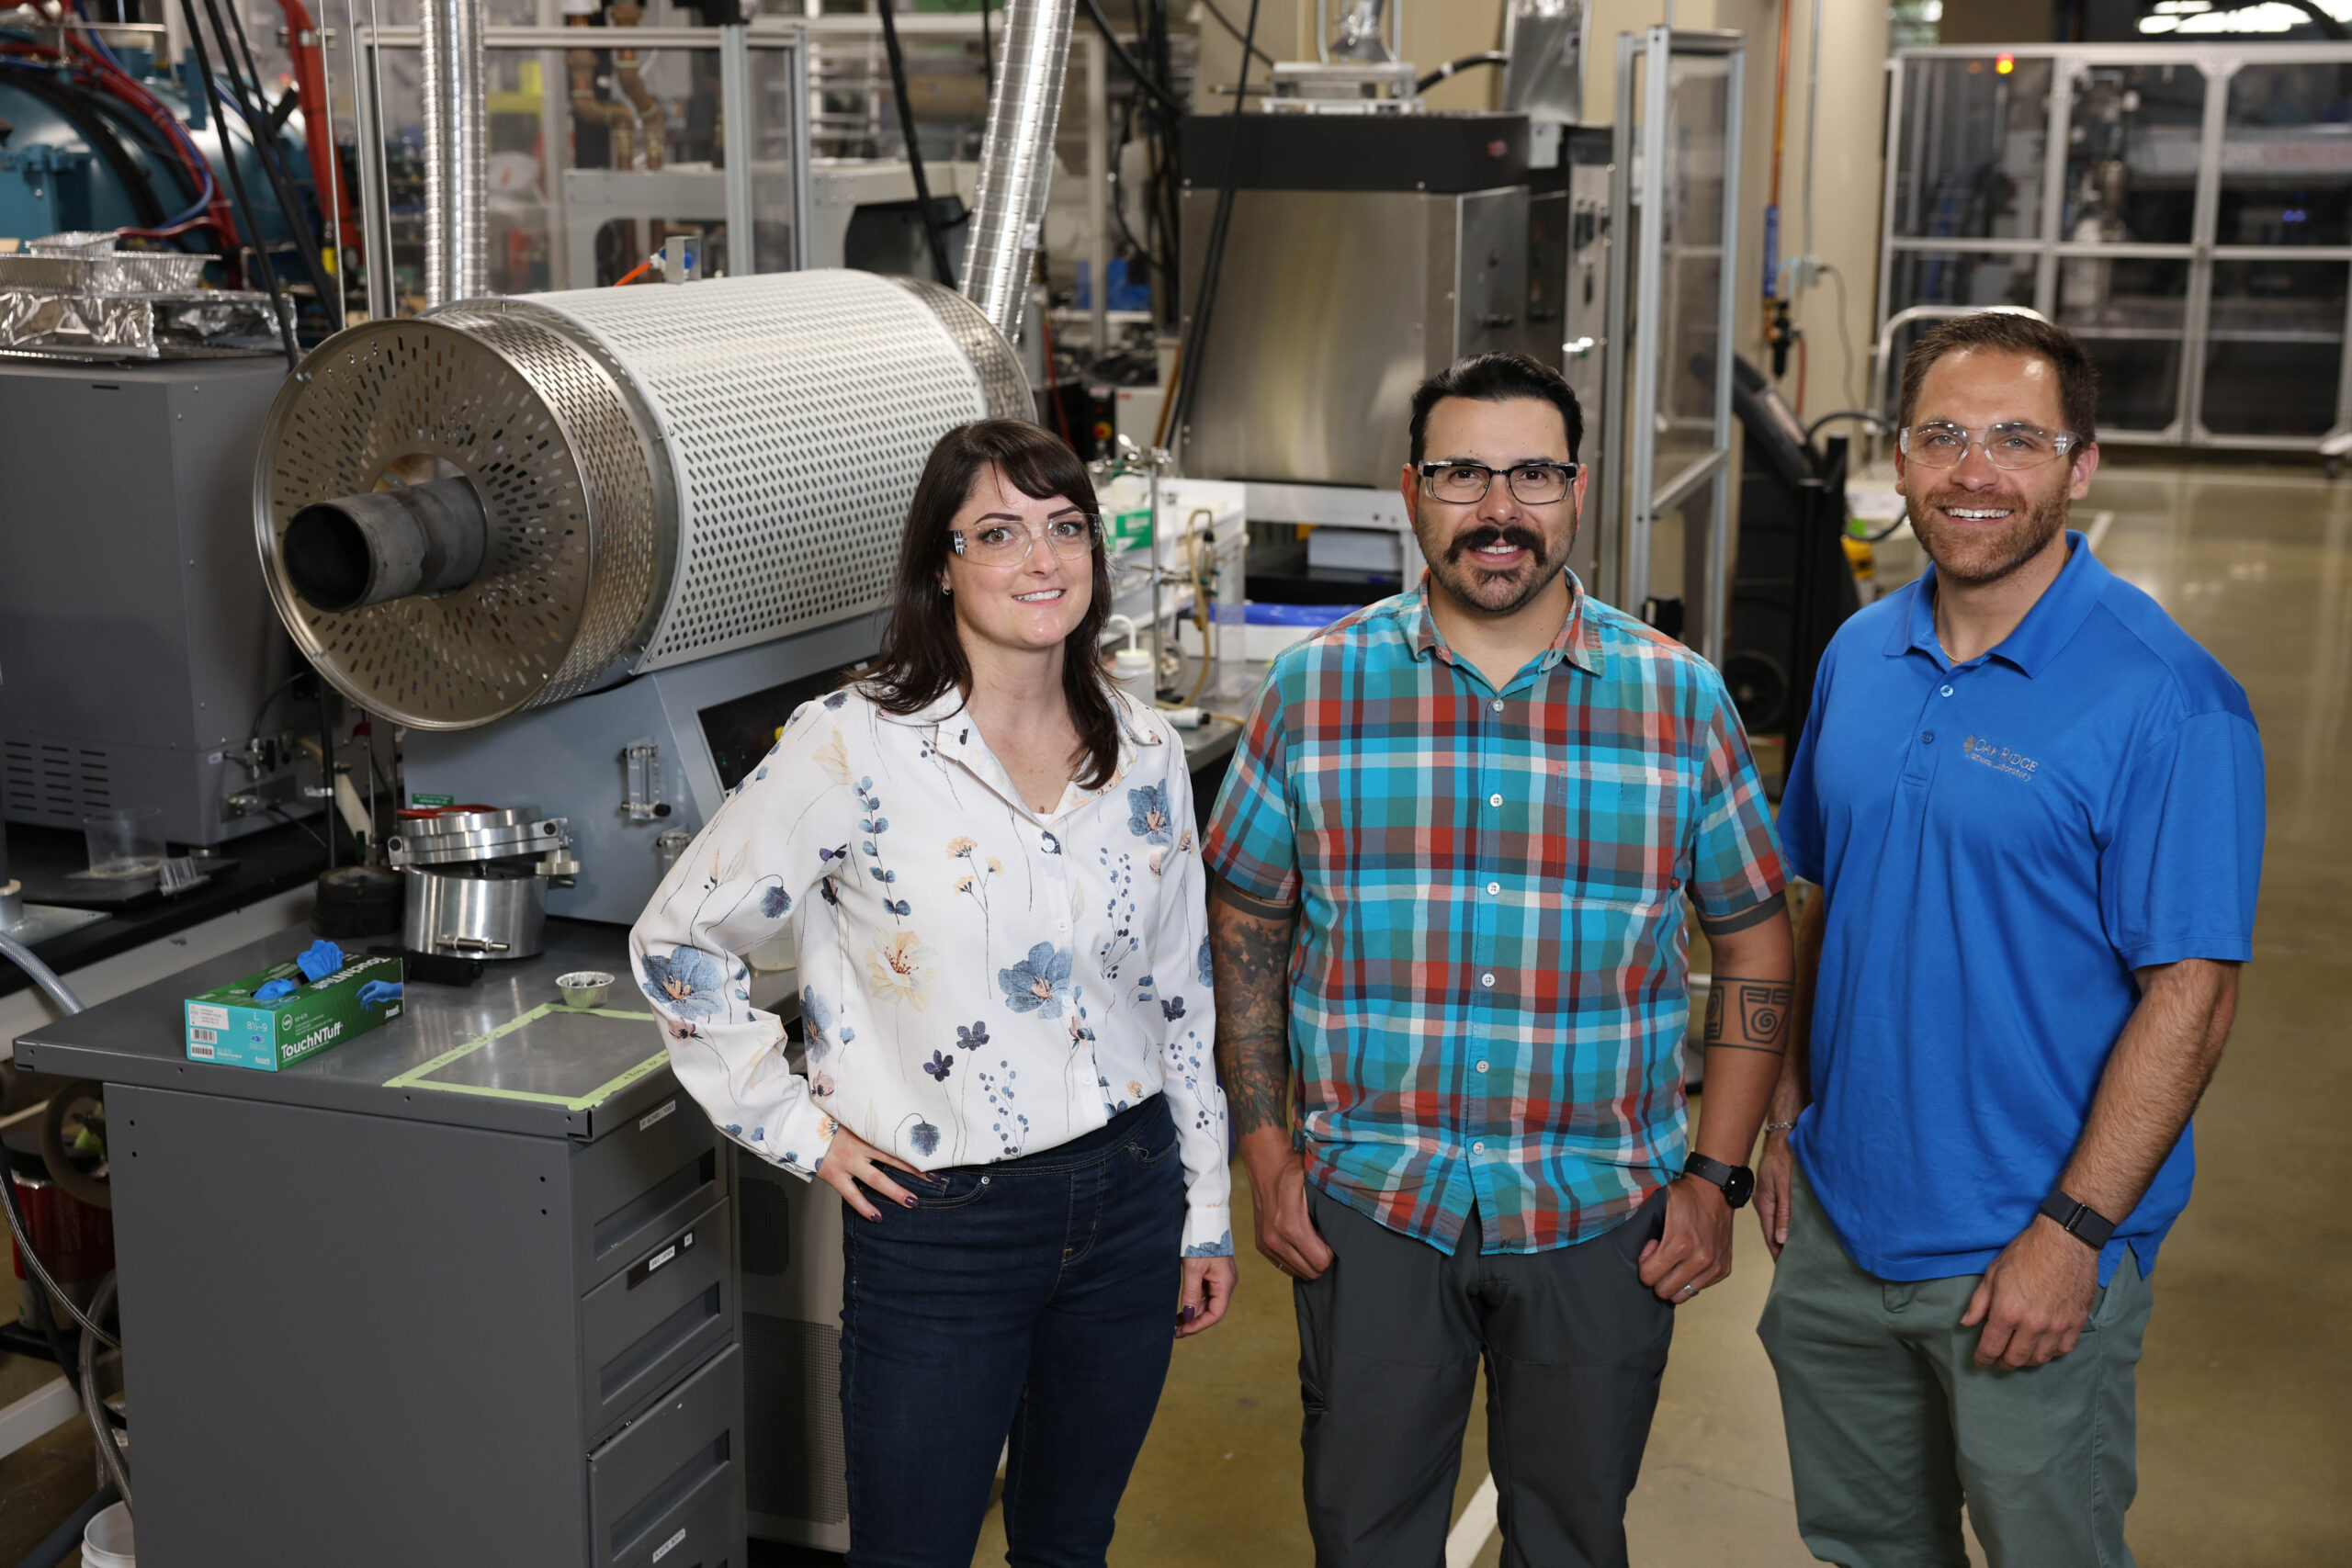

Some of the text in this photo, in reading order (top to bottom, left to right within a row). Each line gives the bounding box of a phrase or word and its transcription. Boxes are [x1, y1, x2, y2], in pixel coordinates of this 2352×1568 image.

[1974, 739, 2039, 773] OAK RIDGE
[254, 1011, 260, 1021] L
[281, 1021, 341, 1059] TouchNTuff
